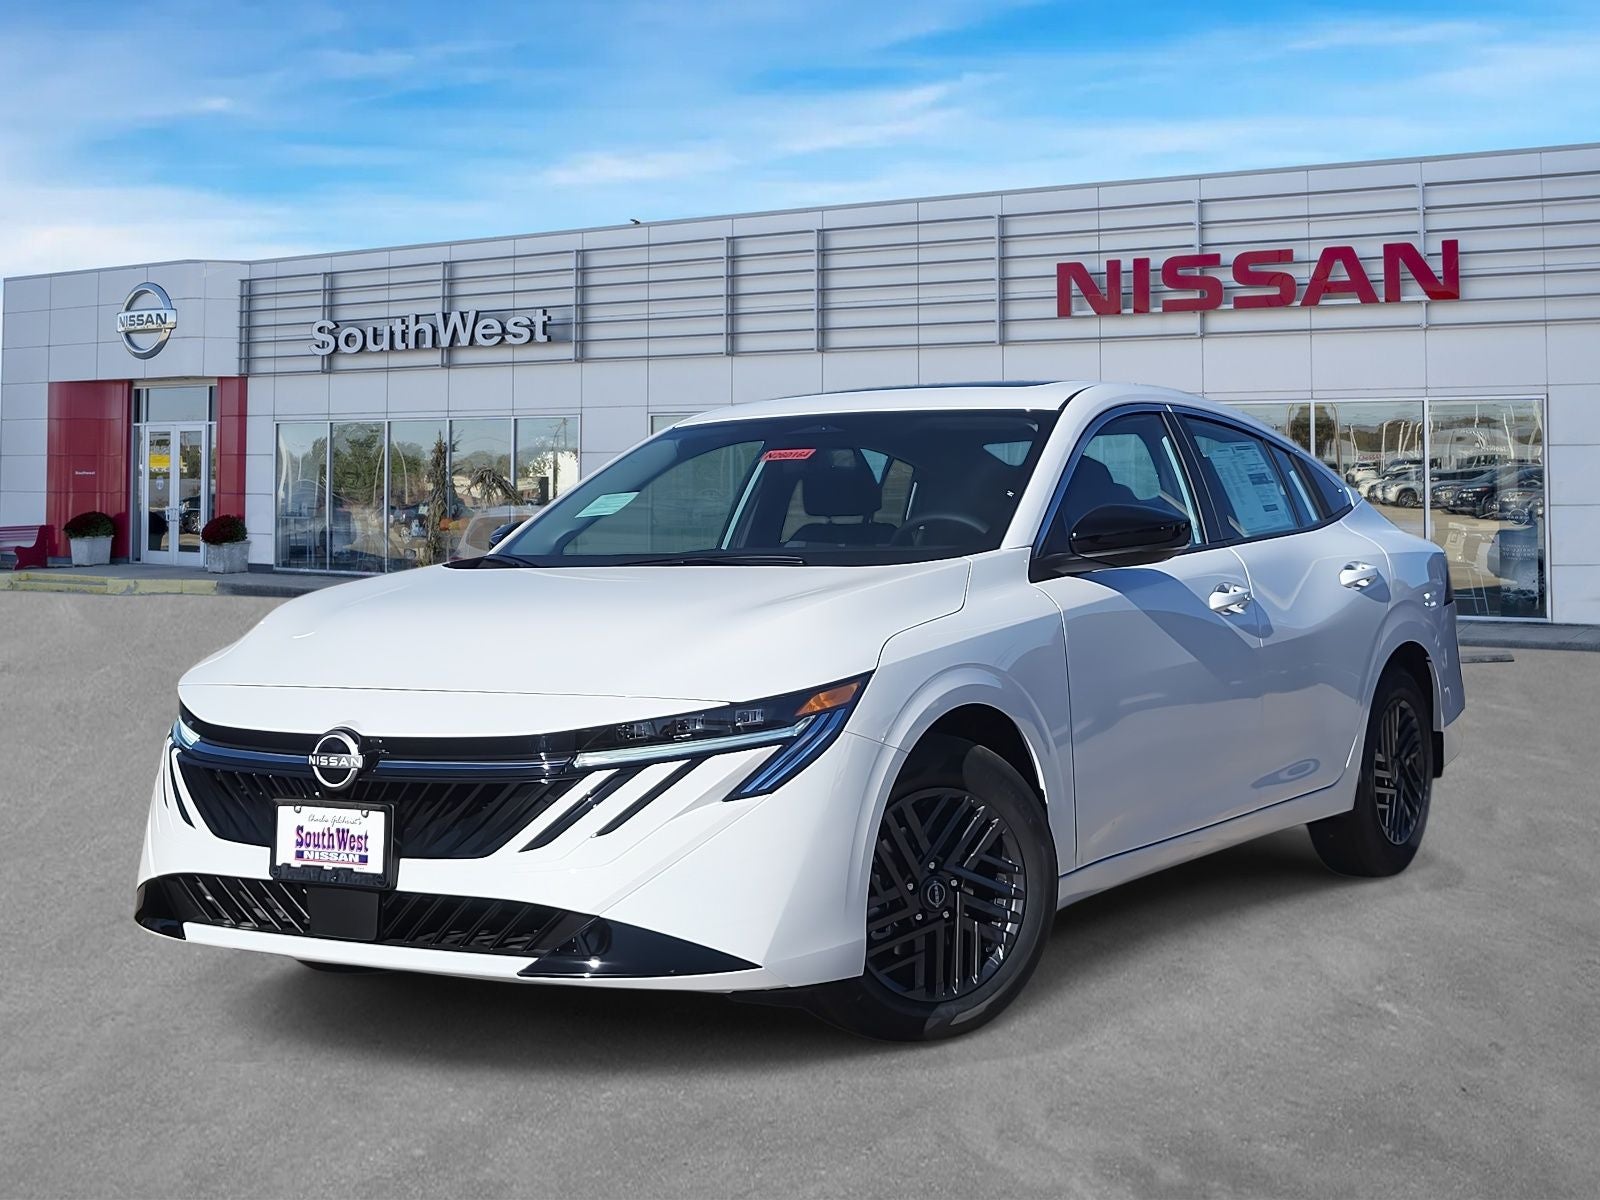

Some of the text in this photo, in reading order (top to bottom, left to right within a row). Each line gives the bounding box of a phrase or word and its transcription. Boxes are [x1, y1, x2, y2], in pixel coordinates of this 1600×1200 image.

[1056, 239, 1461, 318] NISSAN
[118, 312, 168, 328] NISSAN
[309, 308, 549, 356] SouthWest
[308, 754, 363, 768] NISSAN
[295, 824, 369, 853] SouthWest
[303, 850, 360, 862] NISSAN
